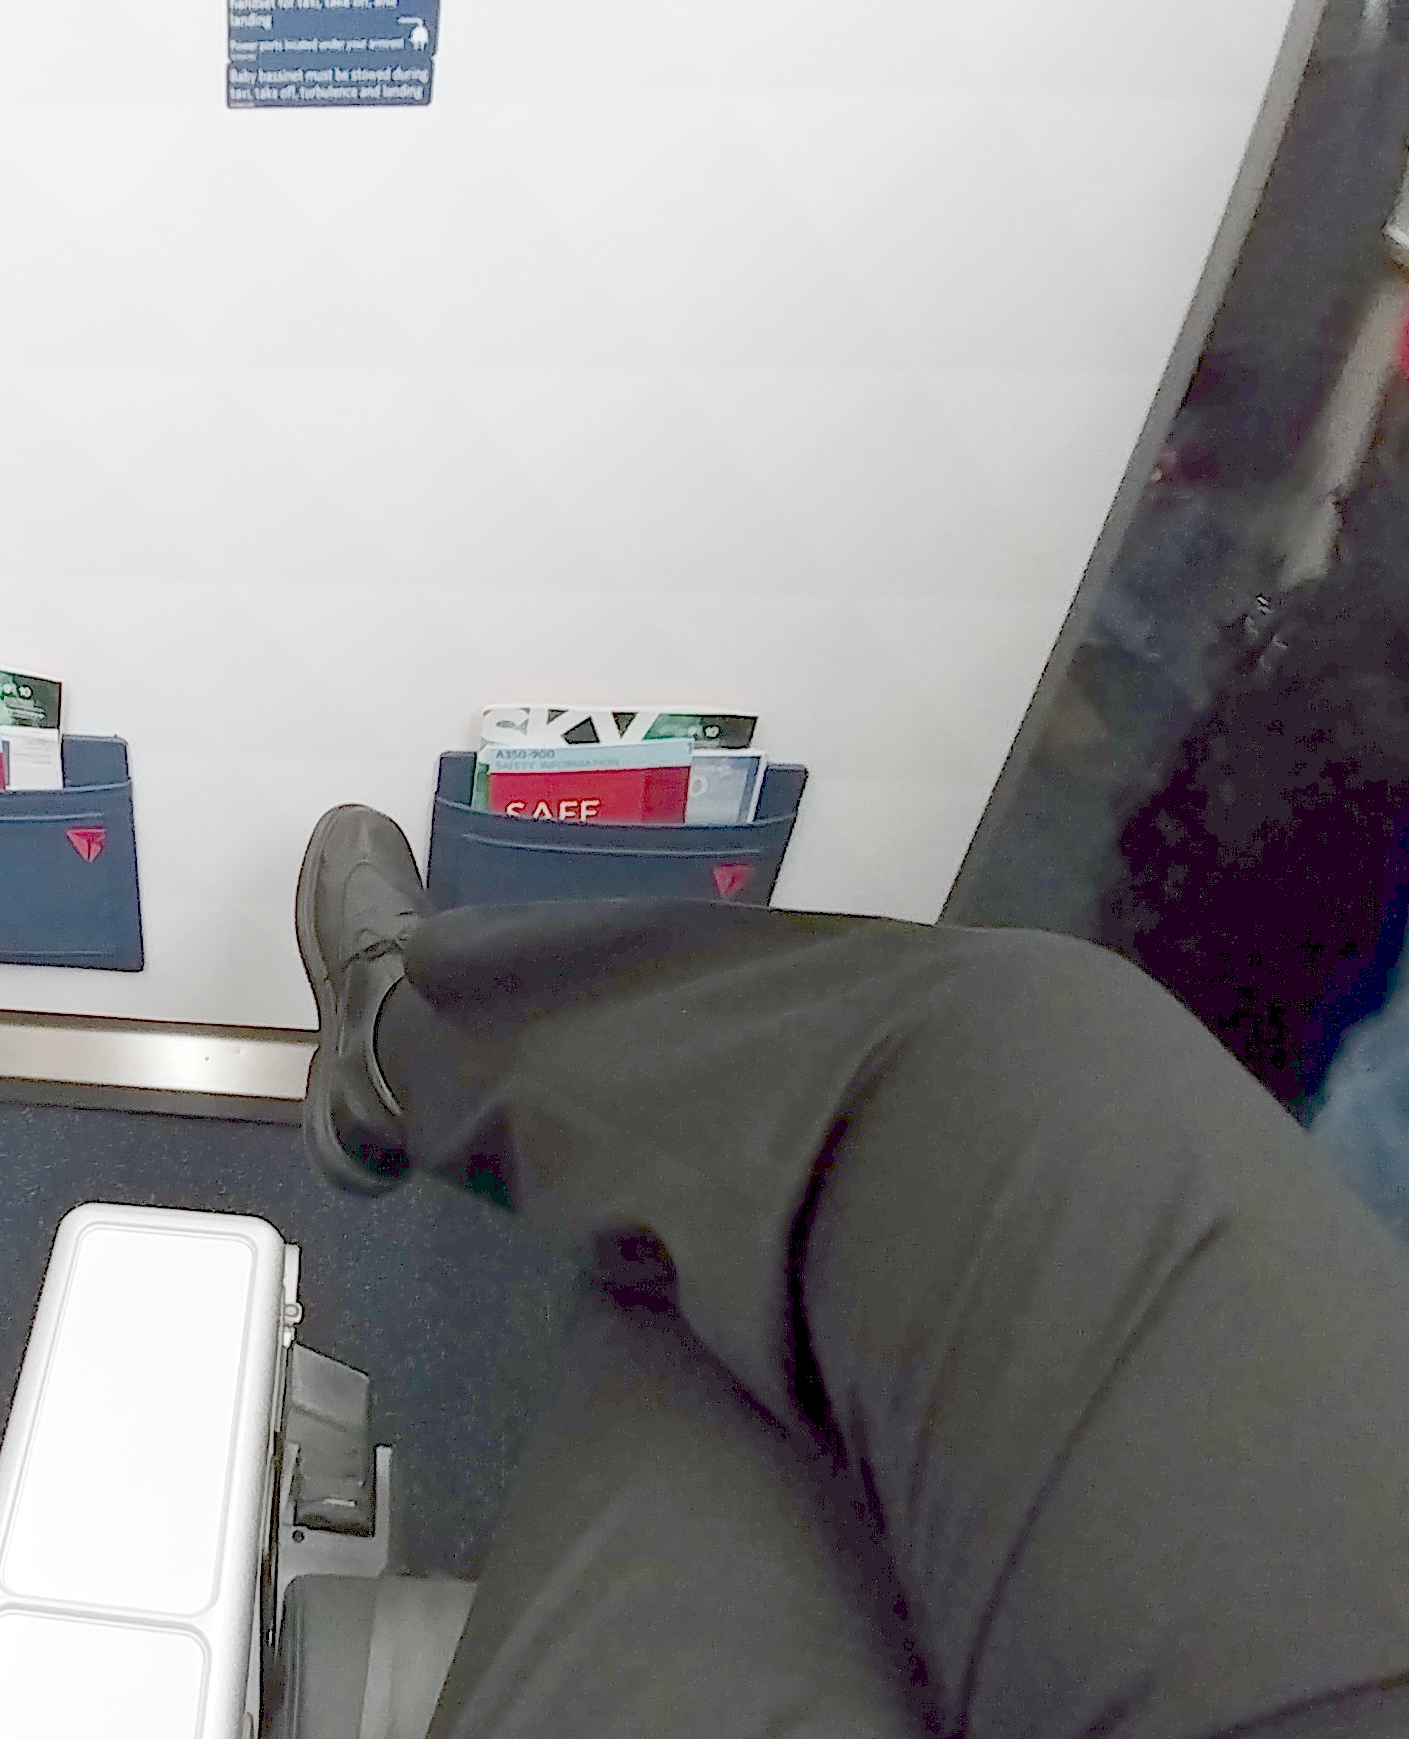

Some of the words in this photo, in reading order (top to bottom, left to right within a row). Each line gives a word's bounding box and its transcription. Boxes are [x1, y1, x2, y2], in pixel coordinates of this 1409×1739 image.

[230, 67, 257, 85] Baby
[258, 66, 303, 82] bassinet
[304, 67, 332, 82] must
[334, 66, 349, 81] be
[350, 66, 391, 81] stowed
[392, 65, 429, 83] during
[253, 86, 278, 99] take
[299, 84, 357, 100] turbulence
[359, 84, 380, 98] and
[382, 83, 422, 100] landing
[481, 706, 659, 748] SKY
[495, 749, 555, 760] A350-900
